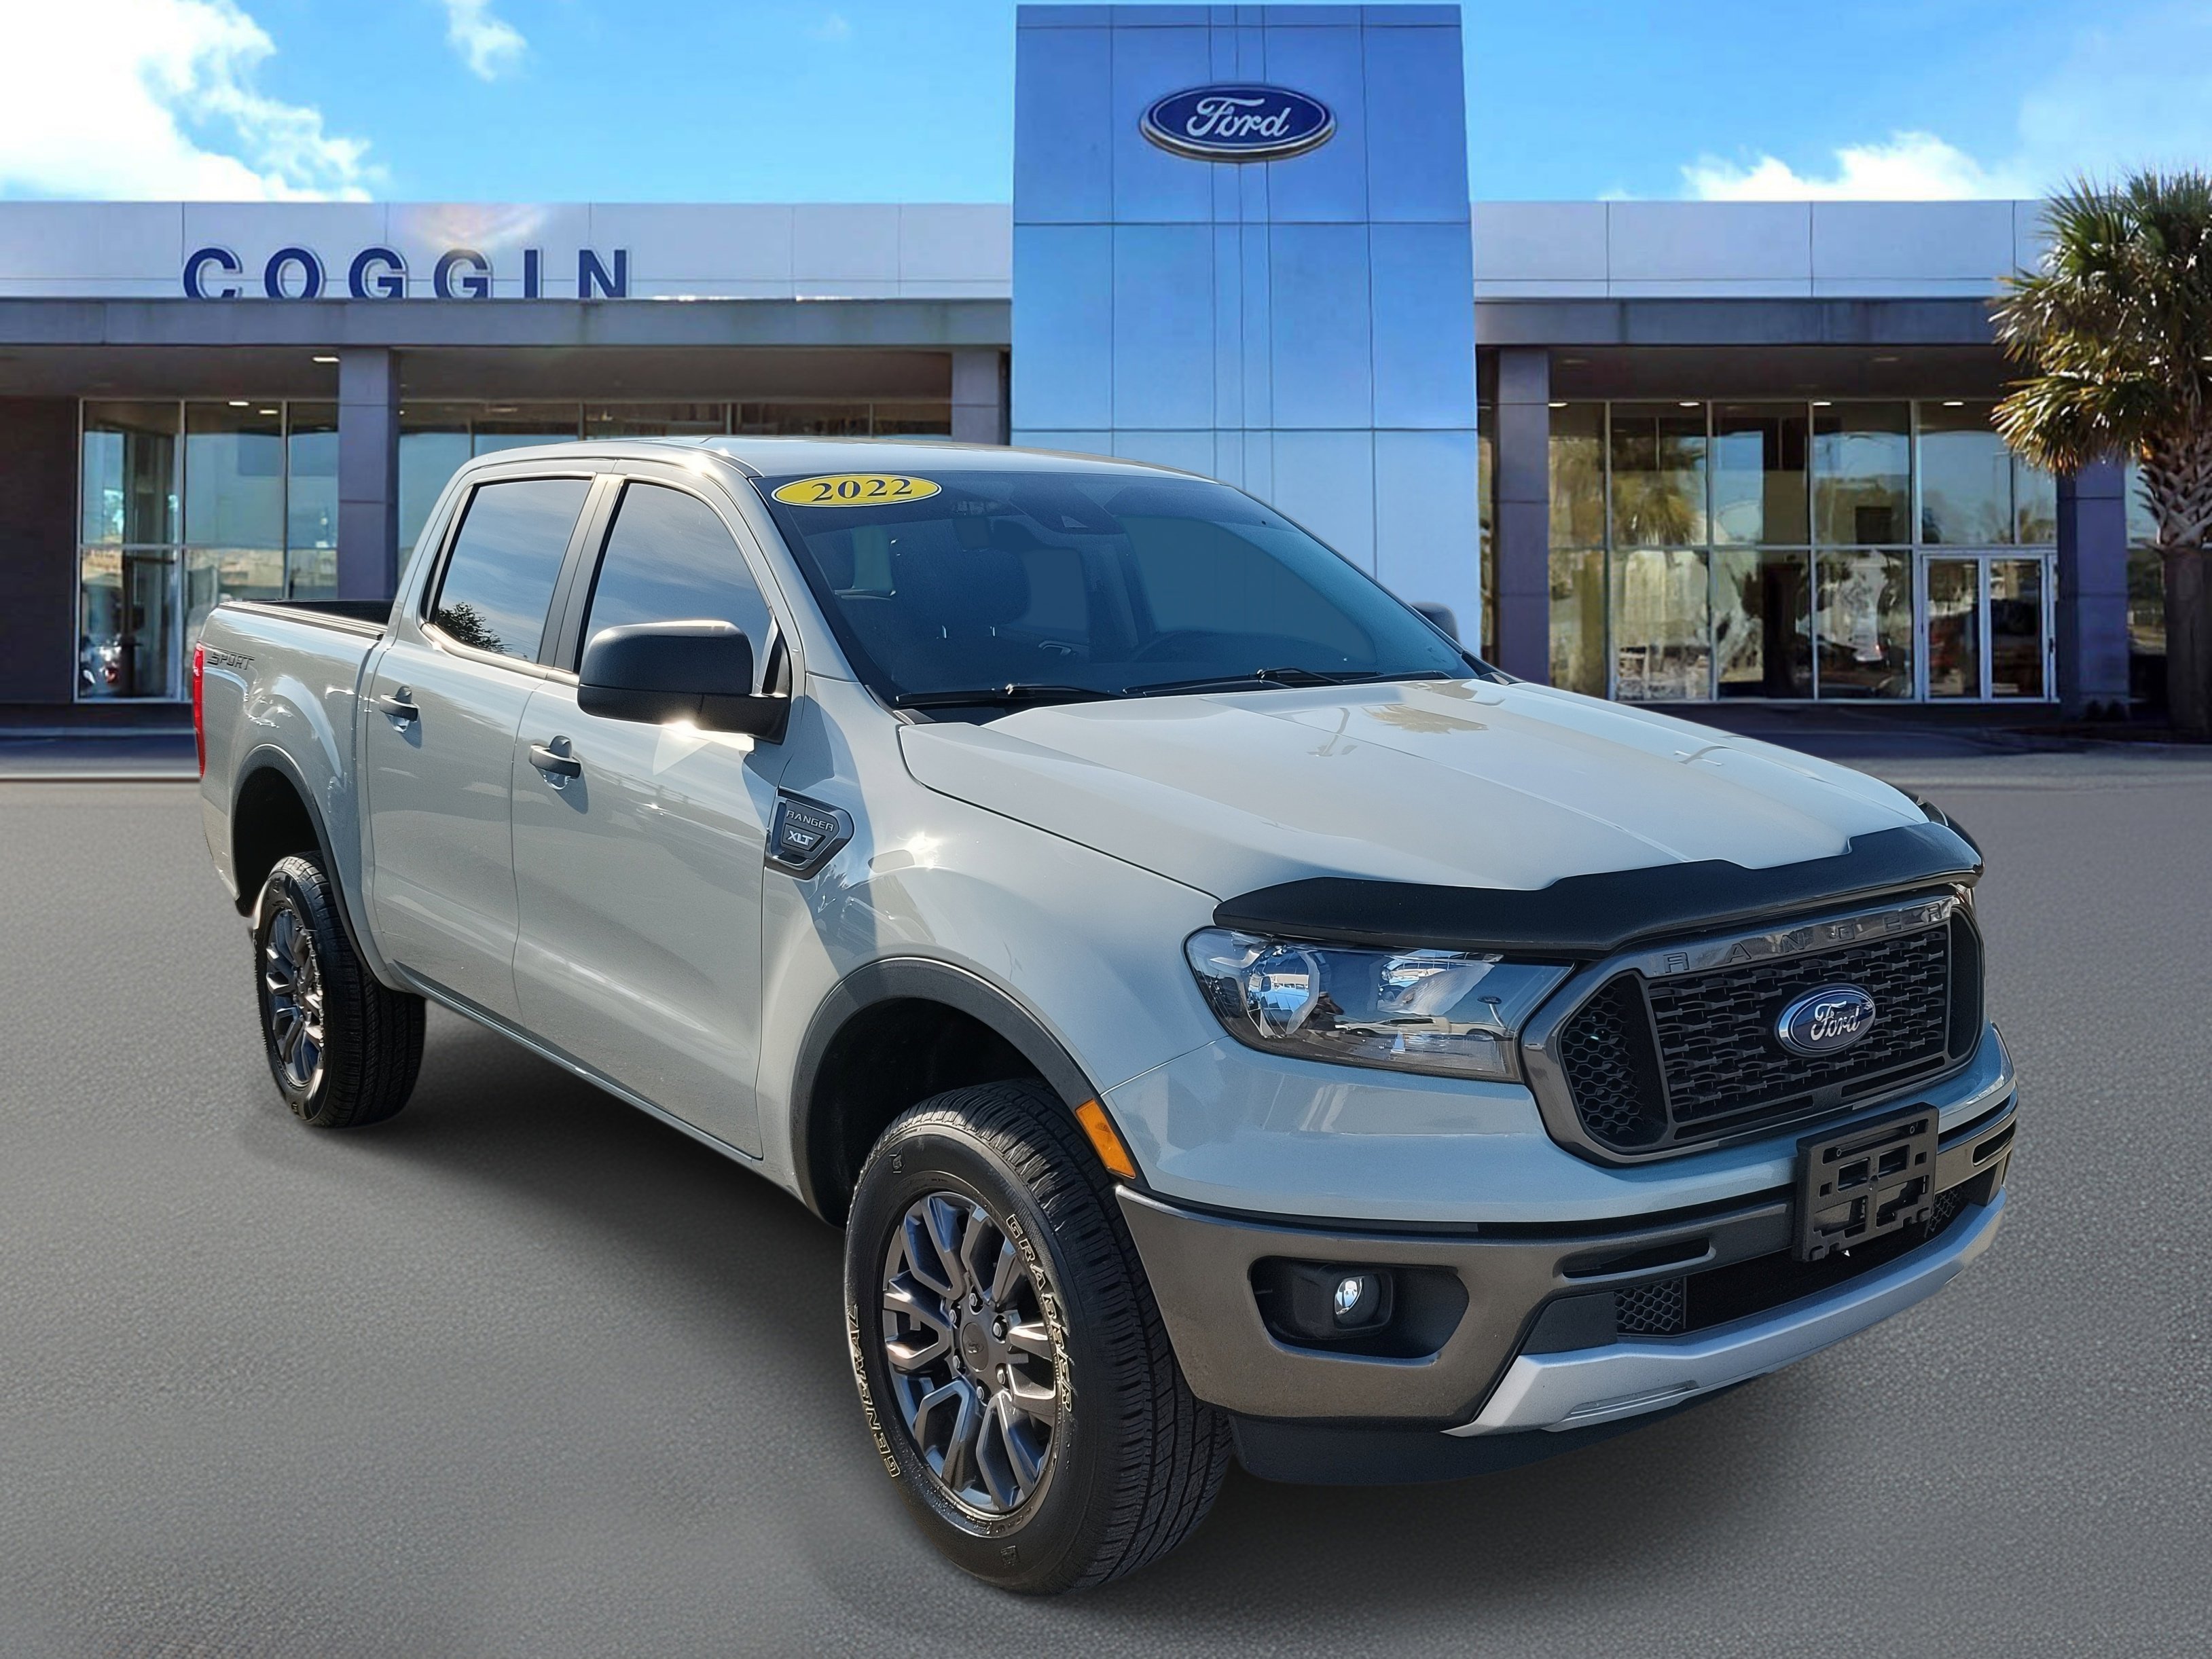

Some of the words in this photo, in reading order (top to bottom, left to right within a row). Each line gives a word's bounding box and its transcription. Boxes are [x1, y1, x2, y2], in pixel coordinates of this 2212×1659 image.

[1186, 97, 1292, 136] Ford
[183, 247, 628, 299] COGGIN
[812, 479, 912, 502] 2022
[206, 651, 255, 670] SPORT
[786, 809, 835, 832] RANGER
[787, 830, 814, 846] XLT
[1663, 902, 1943, 974] RANGER
[1810, 1000, 1861, 1041] Ford
